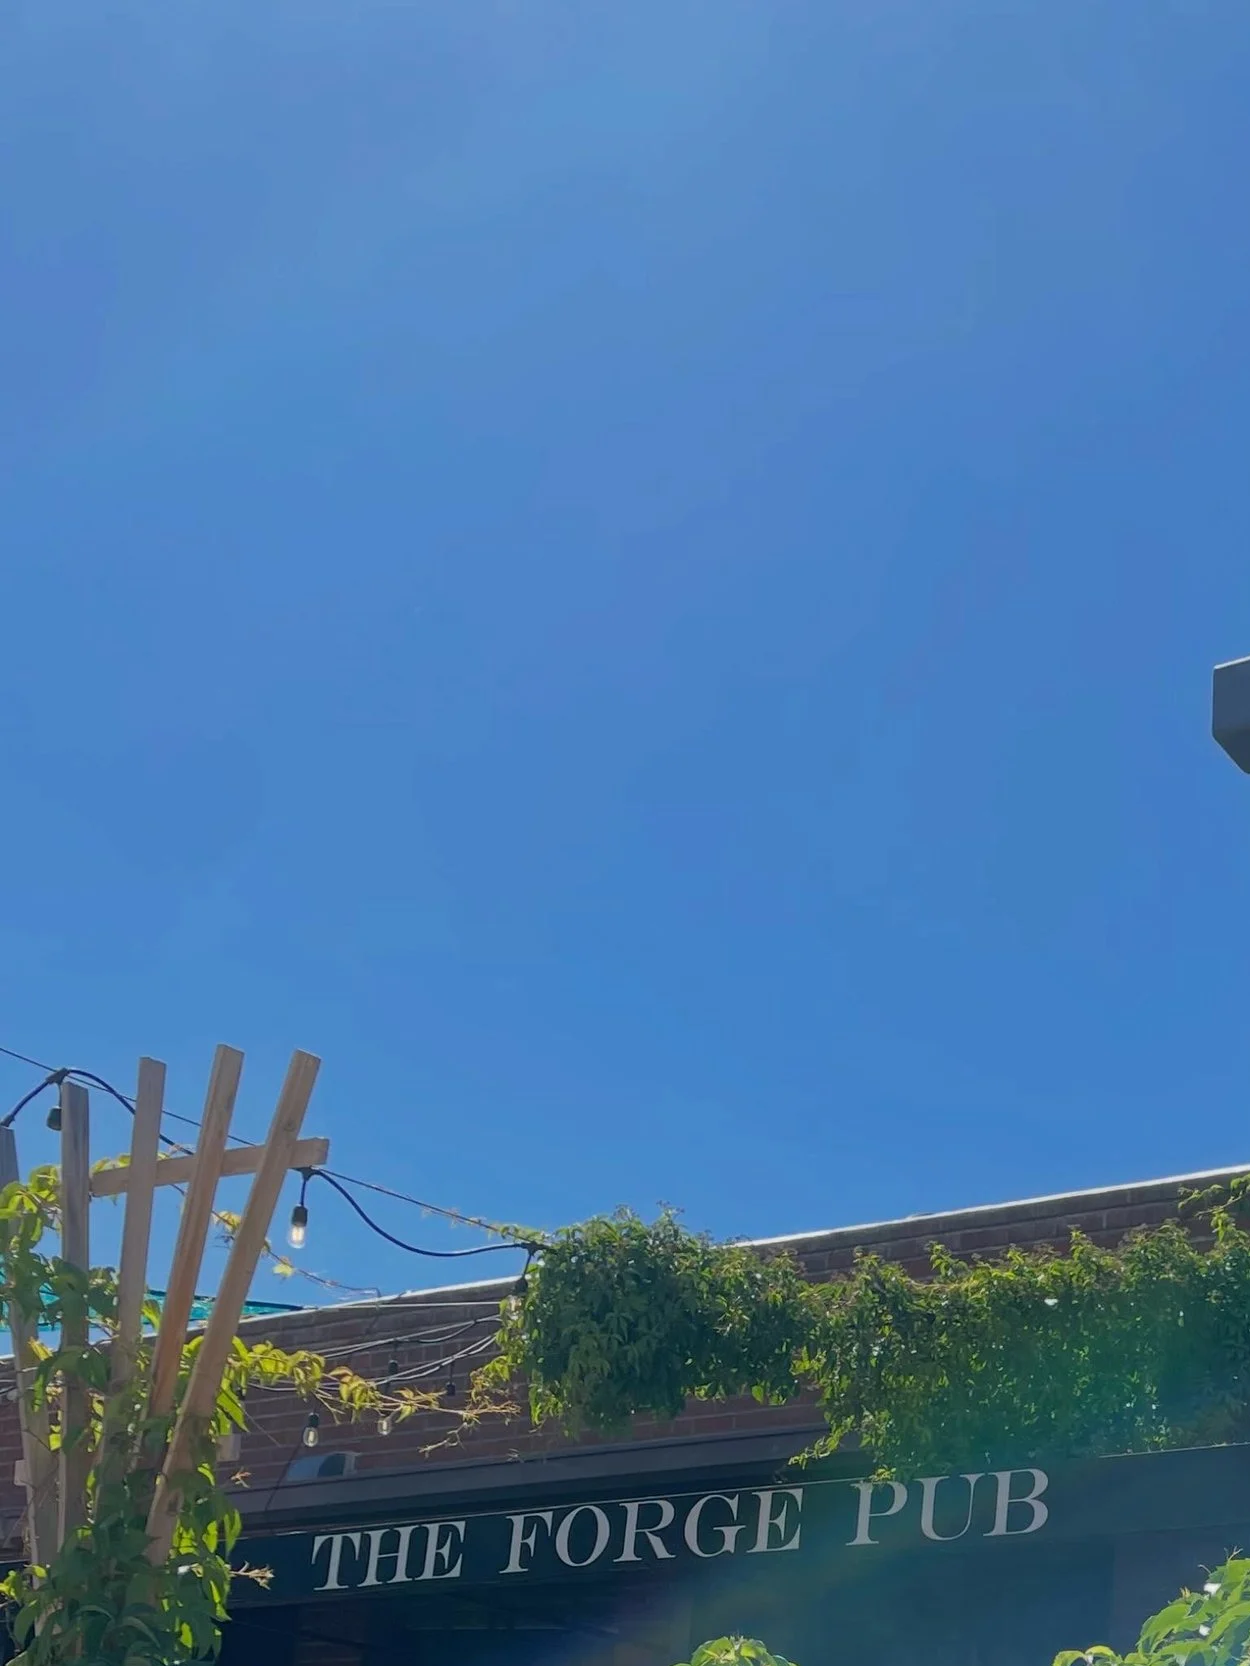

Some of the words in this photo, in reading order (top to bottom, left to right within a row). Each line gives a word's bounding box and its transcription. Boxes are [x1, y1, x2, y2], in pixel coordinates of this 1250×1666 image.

[311, 1520, 467, 1592] THE
[498, 1487, 804, 1574] FORGE
[845, 1467, 1051, 1547] PUB
